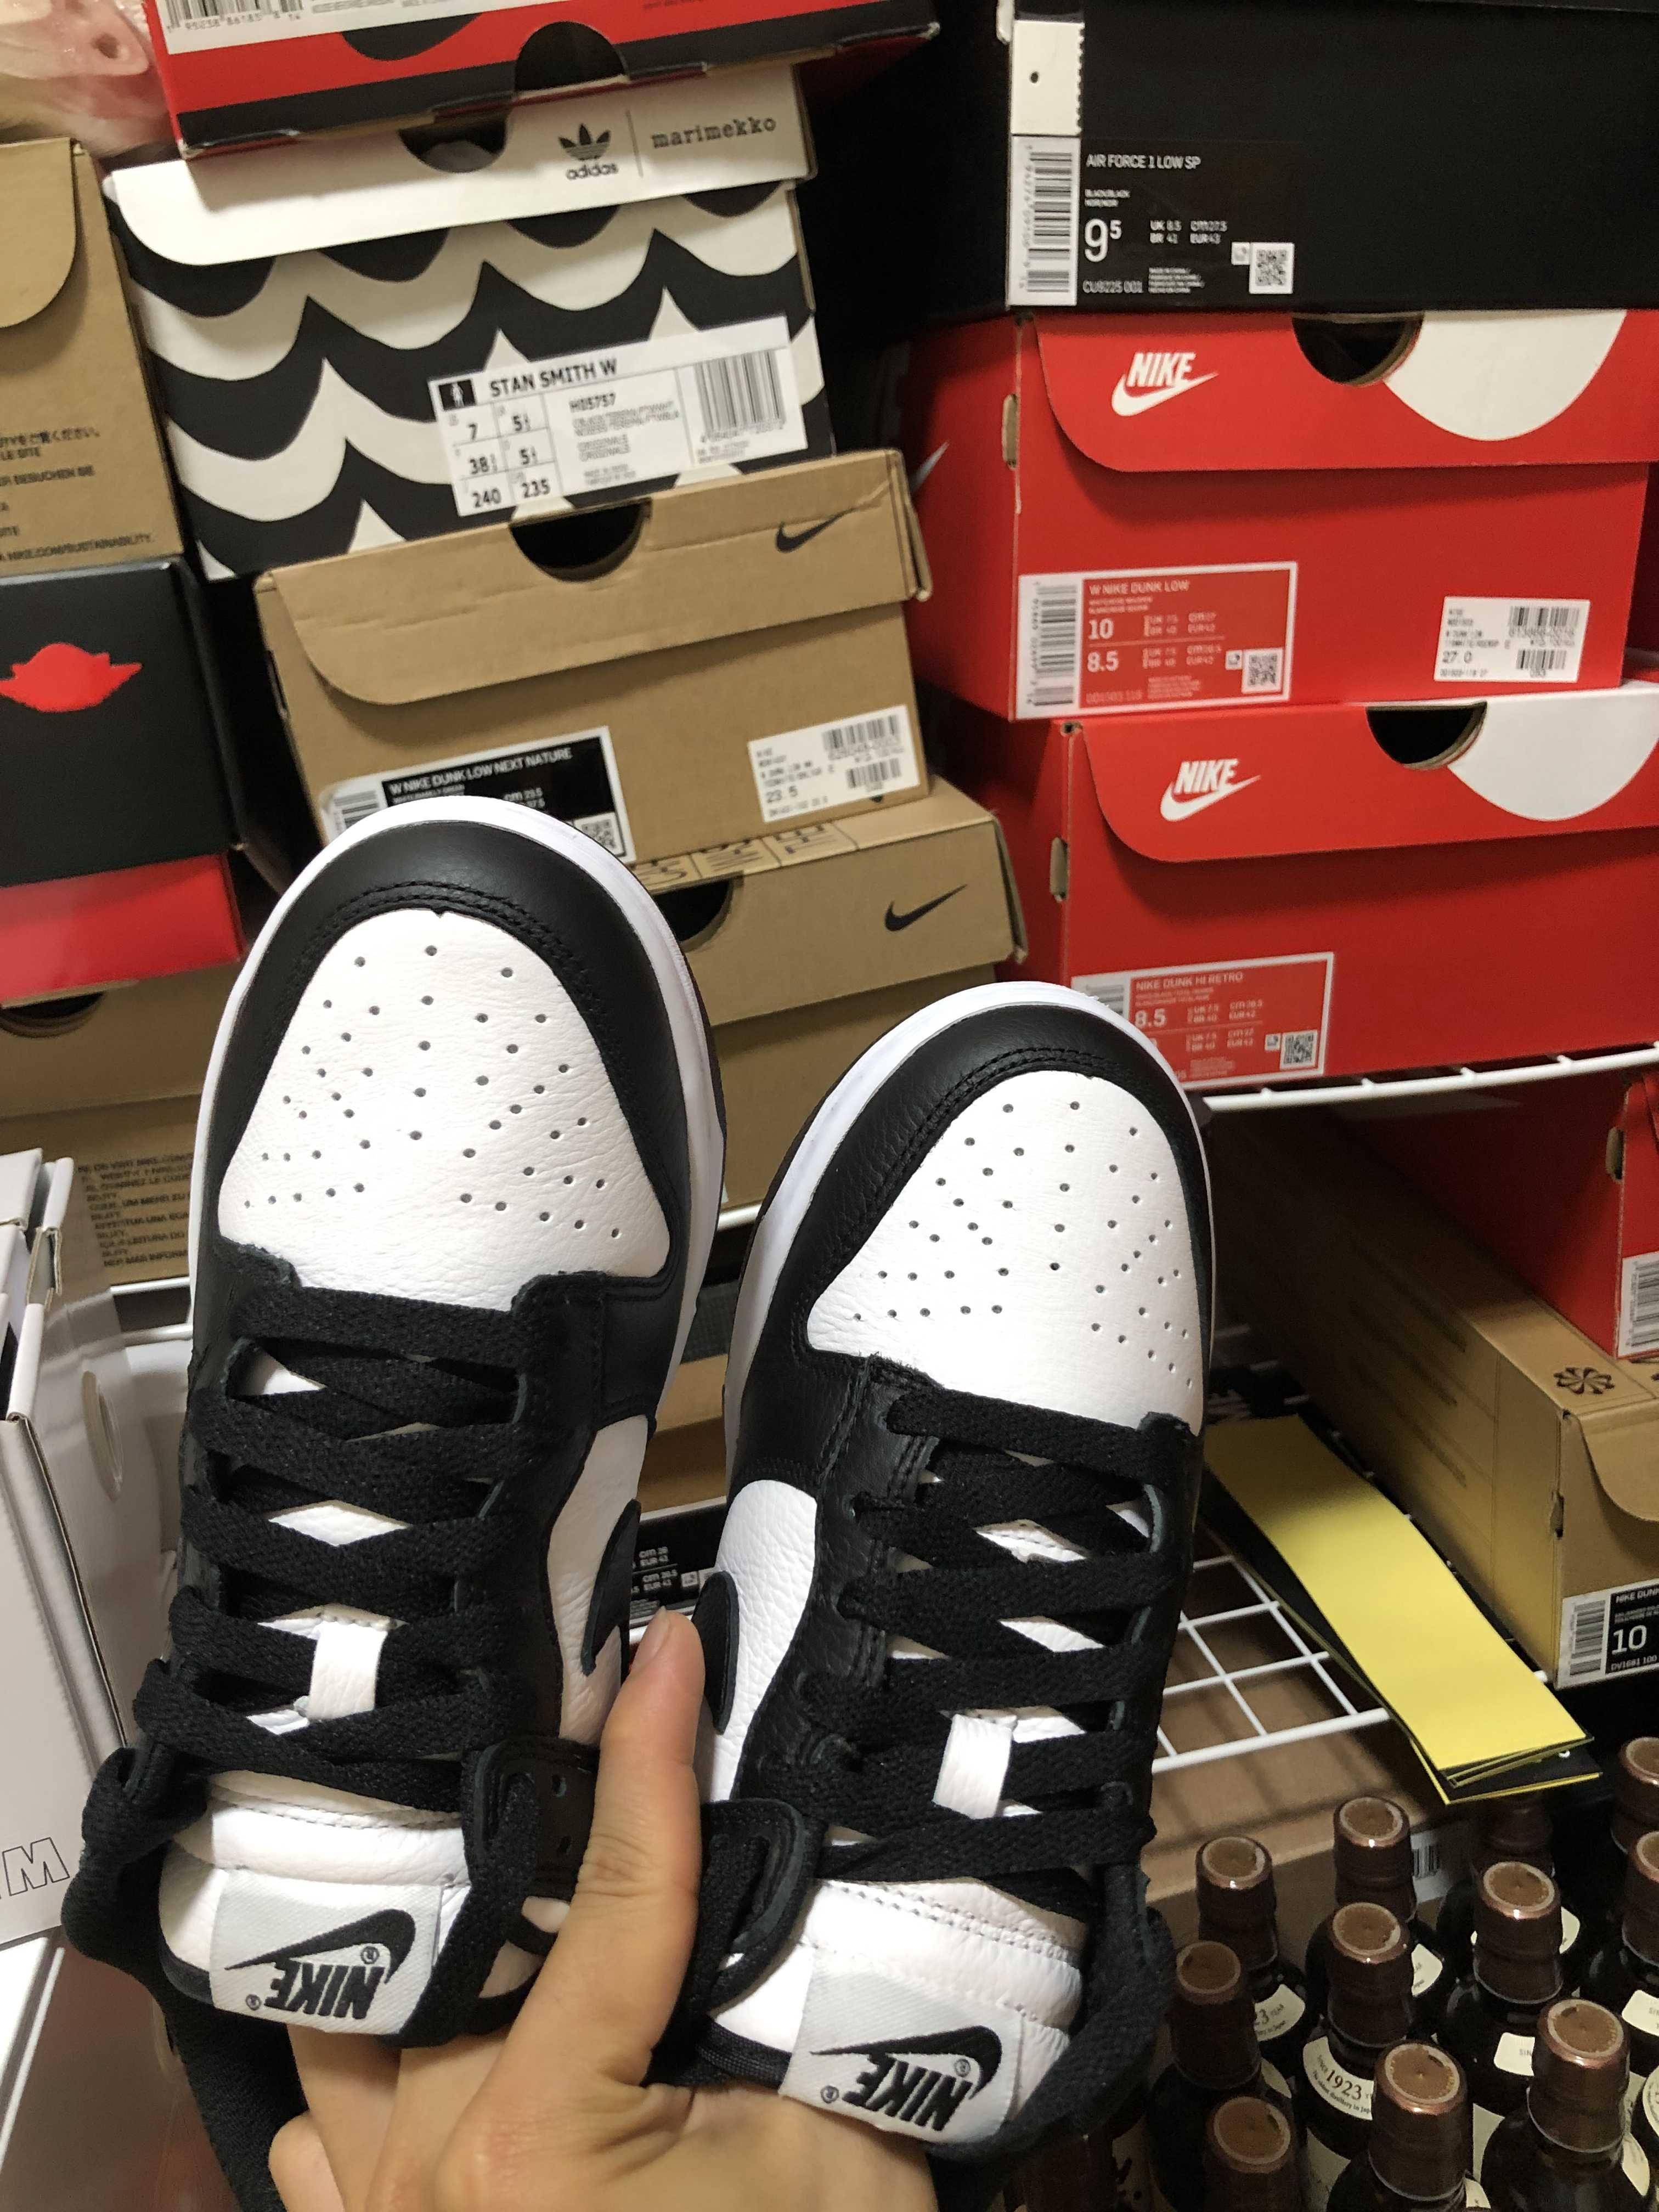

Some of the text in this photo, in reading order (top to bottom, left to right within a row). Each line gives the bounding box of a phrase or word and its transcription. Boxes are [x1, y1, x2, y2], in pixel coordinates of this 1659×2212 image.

[651, 116, 777, 149] marimekko
[566, 162, 619, 180] adidas
[1086, 154, 1201, 169] AIR FORCE 1 LOW SP
[490, 358, 617, 397] STAN SMITH W
[1126, 352, 1197, 387] NIKE
[469, 422, 478, 441] 7
[471, 478, 551, 509] 240 235
[1088, 579, 1190, 596] W NIKE DUNK LOW
[1088, 618, 1114, 640] 10
[1087, 650, 1119, 673] 8.5
[388, 747, 573, 795] W NIKE DUNK LOW NEXT NATURE
[1173, 758, 1239, 795] NIKE
[1136, 972, 1244, 990] NIKE DUNK HI RETRO
[1135, 1008, 1167, 1029] 8.5
[1615, 1591, 1636, 1604] NIKE
[1612, 1625, 1647, 1655] 10
[0, 1837, 71, 1899] M
[263, 1957, 386, 2021] NIKE
[842, 2051, 974, 2131] NIKE
[1327, 2069, 1362, 2101] 1923
